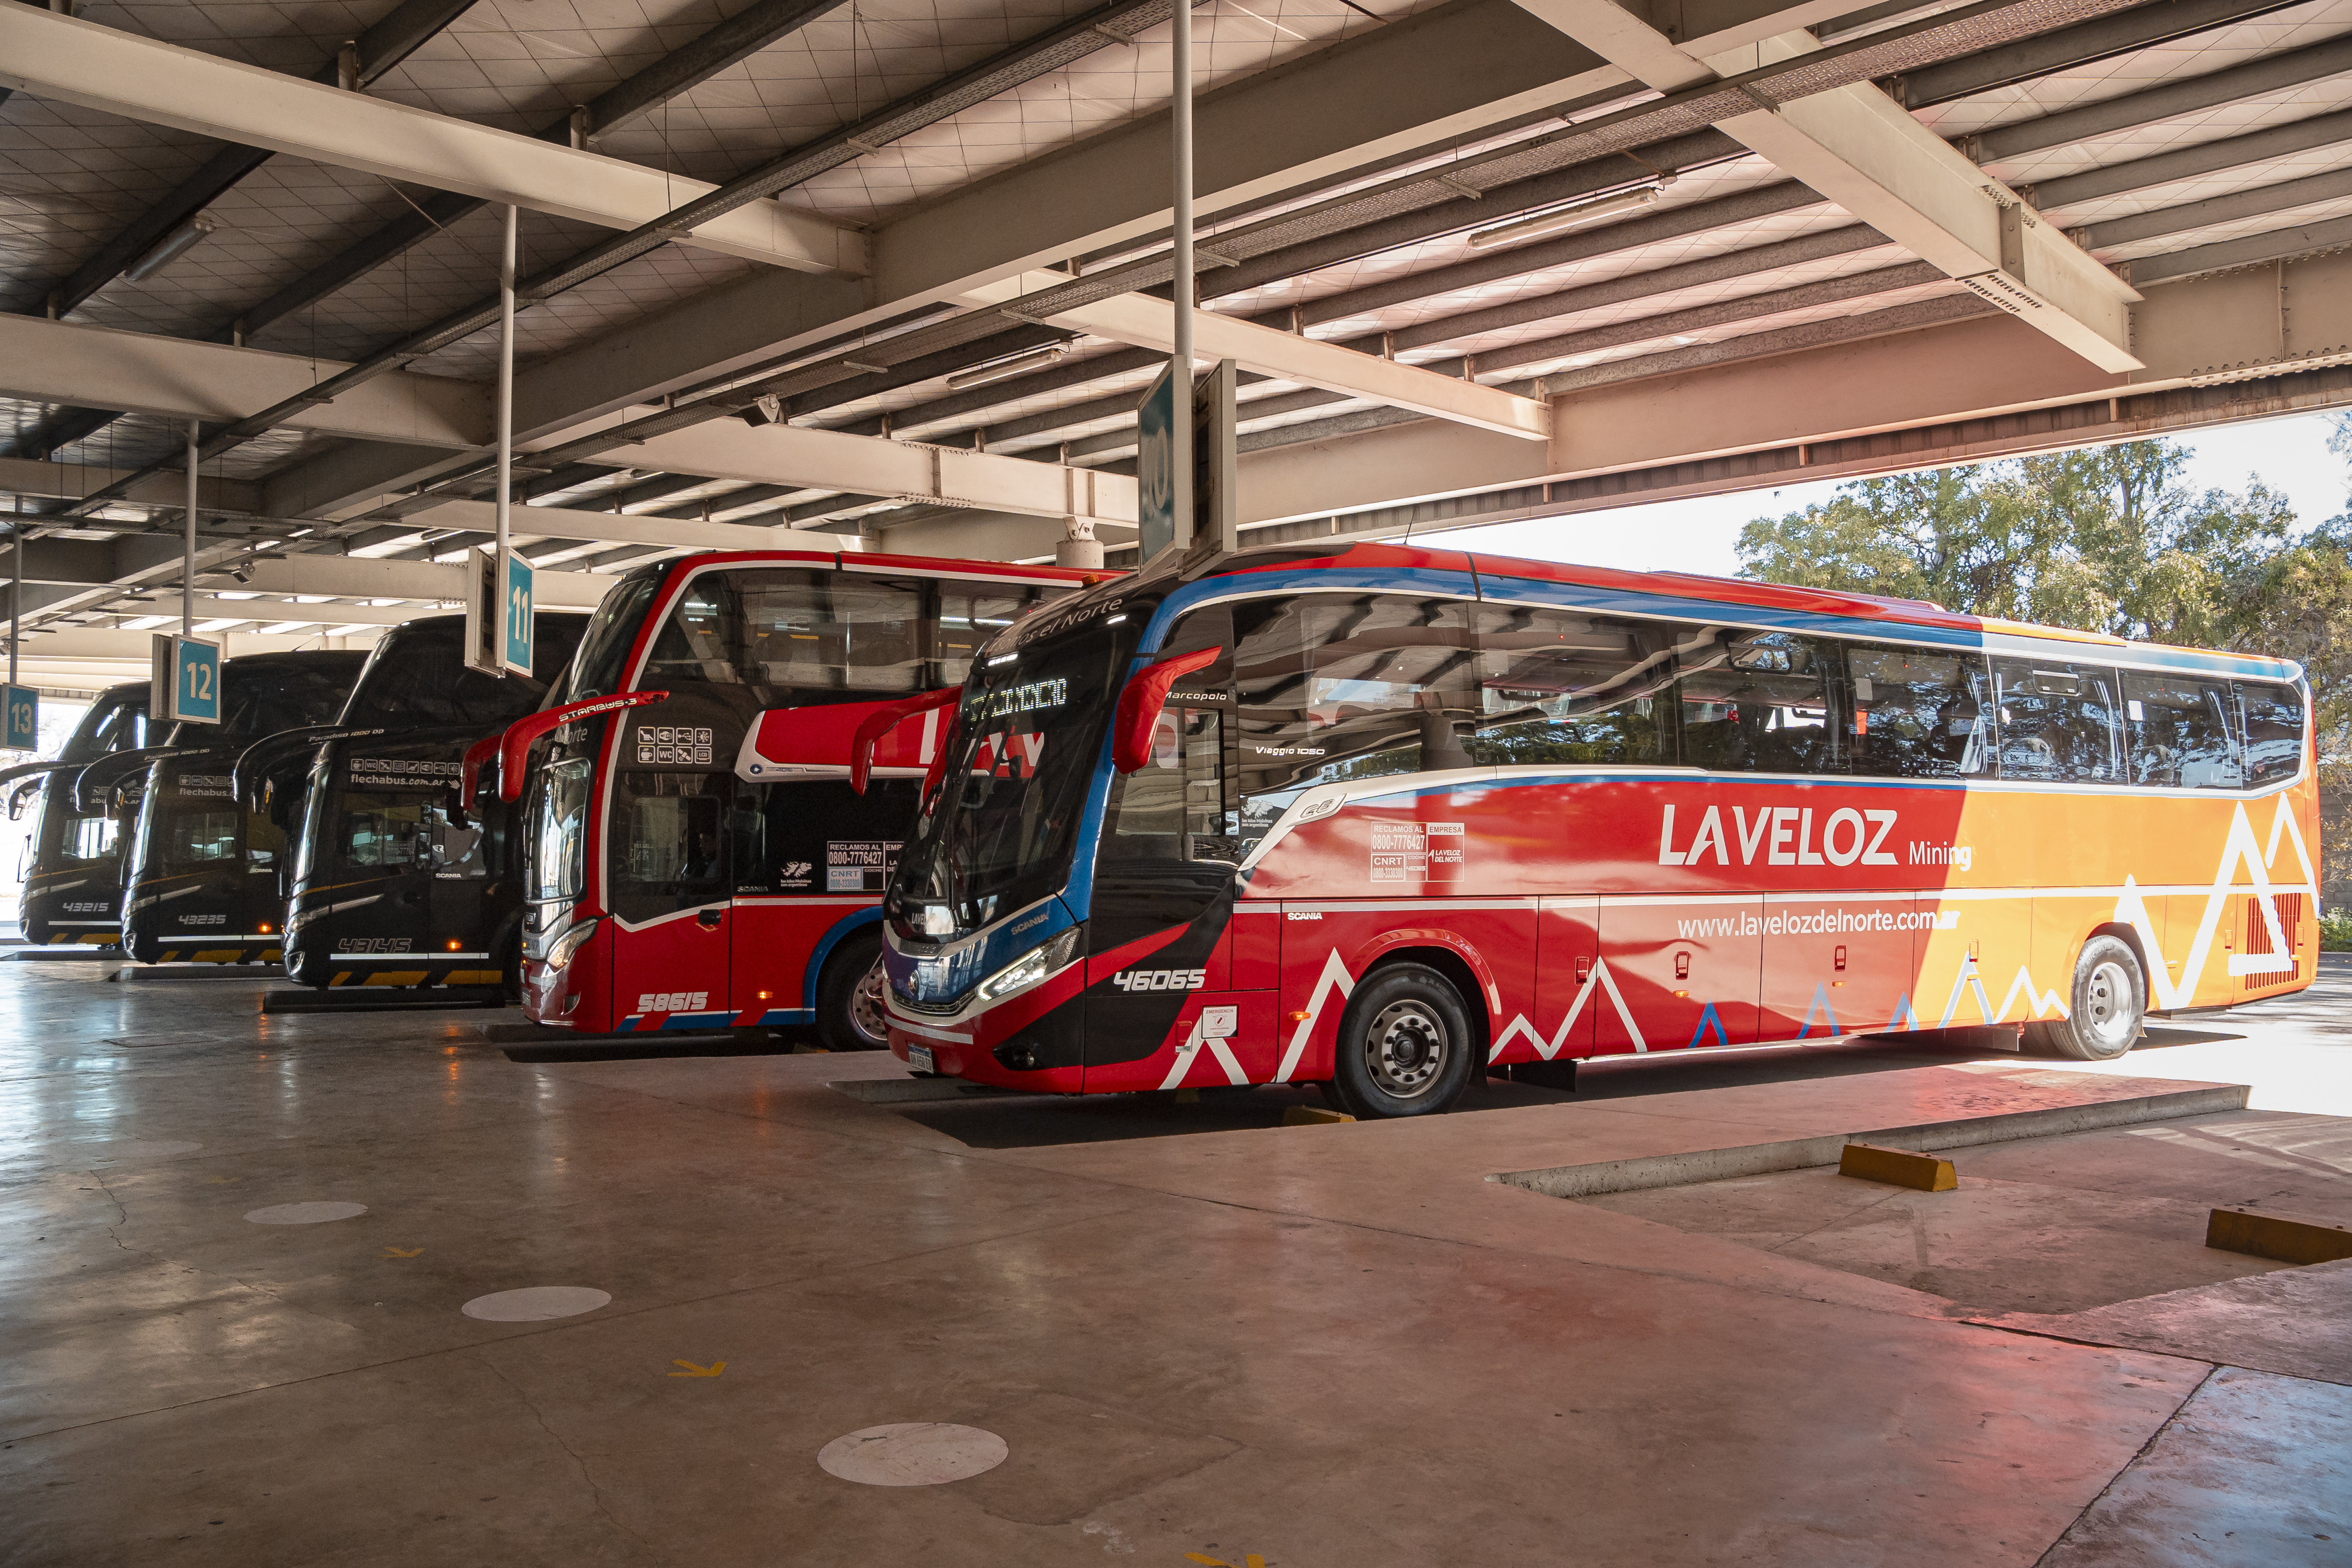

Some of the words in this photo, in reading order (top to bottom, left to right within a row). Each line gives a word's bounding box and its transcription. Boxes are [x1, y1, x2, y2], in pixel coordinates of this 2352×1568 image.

[513, 586, 528, 644] 11
[1040, 619, 1060, 638] el
[1062, 599, 1122, 629] Norte
[187, 662, 211, 701] 12
[12, 703, 32, 734] 13
[308, 733, 348, 742] Paradiso
[1255, 746, 1295, 756] Viaggio
[351, 774, 445, 786] flechabus.com.ar
[1372, 834, 1425, 850] 0800-7776427
[1658, 804, 1899, 867] LAVELOZ
[829, 851, 882, 864] 0800-7776427
[1374, 857, 1402, 865] CNRT
[1909, 840, 1972, 871] Mining
[62, 902, 109, 912] 43215
[179, 914, 226, 925] 43235
[1011, 913, 1049, 935] SCANIA
[1677, 909, 1961, 939] www.lavelozdelnorte.com.ar
[339, 938, 412, 954] 43145
[1114, 969, 1207, 991] 46065
[637, 991, 708, 1012] 58615
